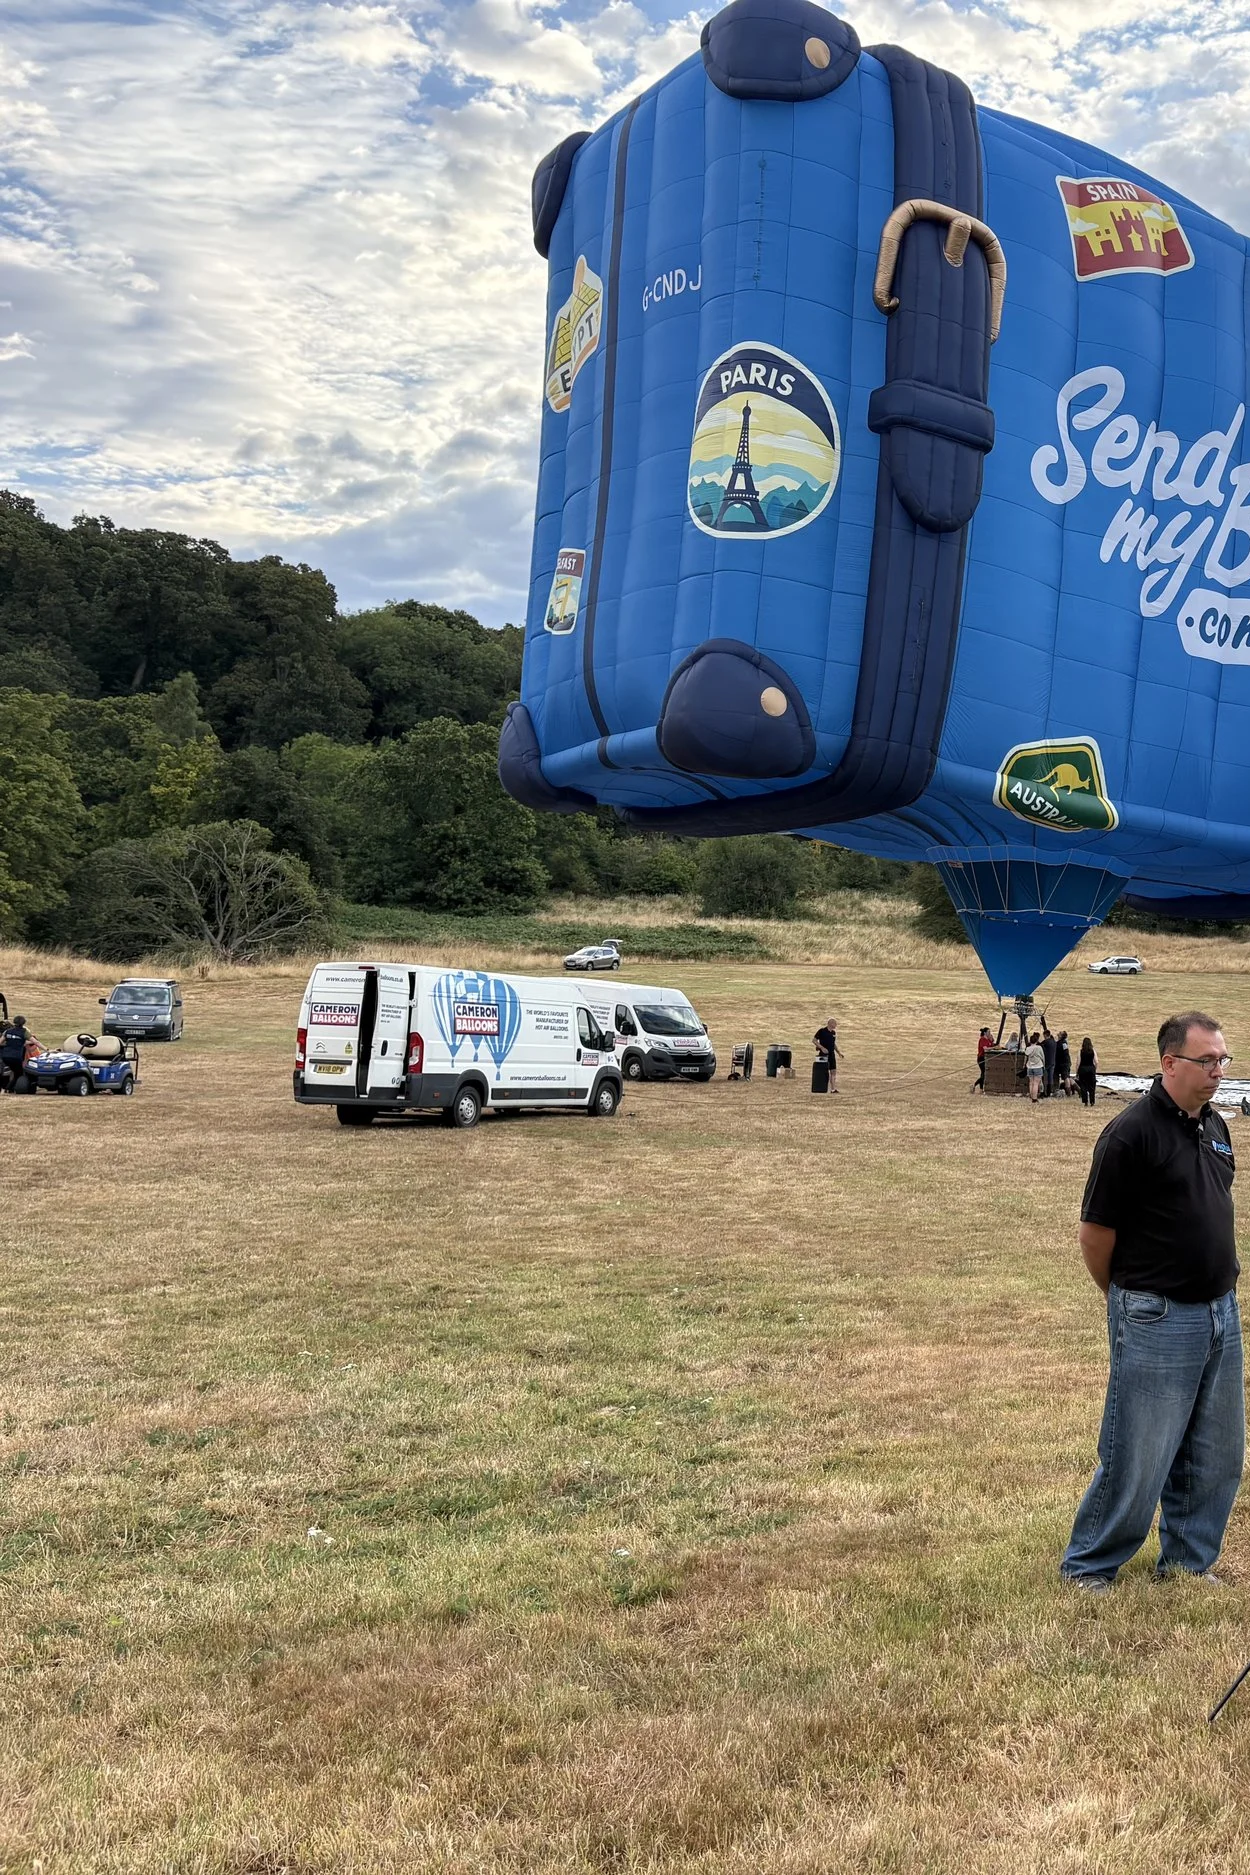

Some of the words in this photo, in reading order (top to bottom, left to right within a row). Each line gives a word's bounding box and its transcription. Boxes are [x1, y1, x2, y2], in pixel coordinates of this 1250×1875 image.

[1086, 183, 1139, 202] SPAIN
[642, 264, 702, 312] G-CNDJ
[720, 362, 796, 396] PARIS
[1030, 365, 1245, 507] Send
[1099, 498, 1214, 617] my
[1010, 781, 1079, 826] AUSTRA
[312, 1014, 357, 1024] BALLOONS
[313, 1005, 357, 1014] CAMERON
[456, 1004, 498, 1018] CAMERON
[456, 1019, 498, 1033] BALLOONS
